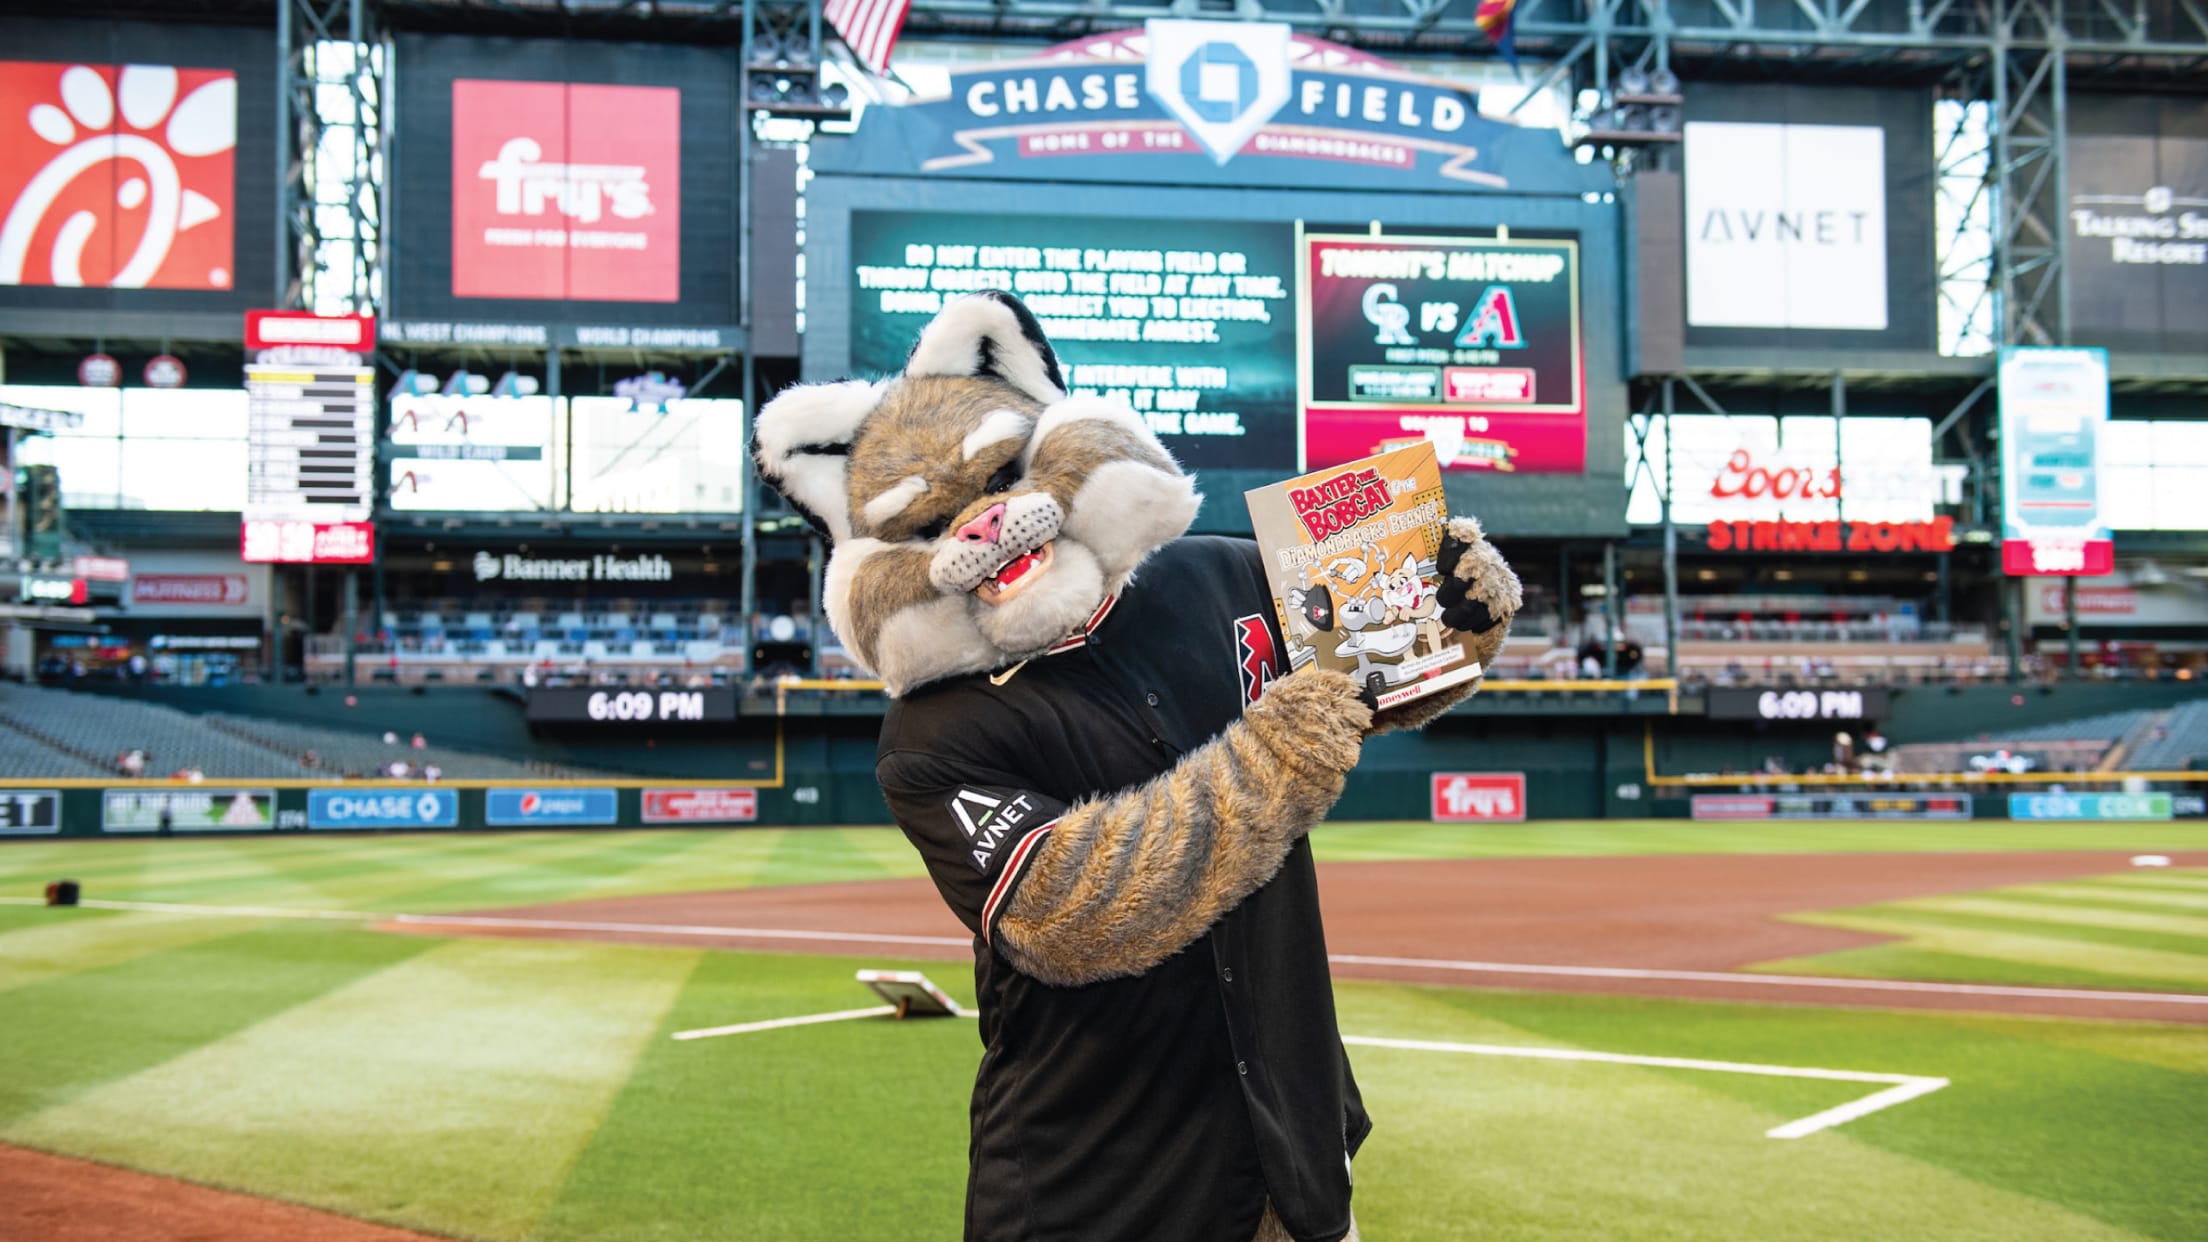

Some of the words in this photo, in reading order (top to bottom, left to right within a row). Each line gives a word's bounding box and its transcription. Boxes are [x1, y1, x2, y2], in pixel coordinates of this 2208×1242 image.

[966, 73, 1140, 118] CHASE
[1302, 79, 1466, 131] FIELD
[1028, 134, 1091, 152] HOME
[1101, 132, 1131, 149] OF
[1144, 131, 1183, 149] THE
[1255, 134, 1407, 165] DIAMONDBACKS
[1702, 209, 1871, 245] AVNET
[905, 245, 935, 266] DO
[936, 246, 977, 267] NOT
[978, 246, 1041, 269] ENTER
[1043, 248, 1082, 270] THE
[1084, 249, 1163, 272] PLAYING
[1165, 251, 1217, 273] FIELD
[1218, 252, 1247, 274] OR
[1320, 249, 1447, 280] TONIGHT'S
[1447, 252, 1565, 282] MATCHUP
[856, 266, 929, 290] THROW
[930, 268, 1012, 291] OBJECTS
[1014, 271, 1068, 293] ONTO
[1069, 272, 1108, 294] THE
[1109, 273, 1162, 296] FIELD
[1163, 275, 1189, 296] AT
[1190, 275, 1232, 297] ANY
[1107, 296, 1149, 318] YOU
[1150, 297, 1177, 319] TO
[1420, 302, 1459, 333] VS
[453, 324, 547, 344] CHAMPIONS
[576, 327, 630, 345] WORLD
[631, 328, 720, 347] CHAMPIONS
[1175, 366, 1227, 389] WITH
[1710, 449, 1842, 499] Coors
[1289, 472, 1361, 514] BAXTER
[1356, 467, 1378, 483] THE
[1302, 478, 1393, 543] BOBCAT
[1707, 520, 1842, 552] STRIKE
[1846, 516, 1955, 552] ZONE
[503, 554, 591, 580] Banner
[593, 554, 672, 580] Health
[588, 692, 653, 721] 6:09
[658, 692, 705, 720] PM
[1378, 685, 1423, 708] oneywell
[1758, 692, 1821, 720] 6:09
[1827, 692, 1864, 719] PM
[327, 796, 412, 820] CHASE
[972, 793, 1033, 869] AVNET
